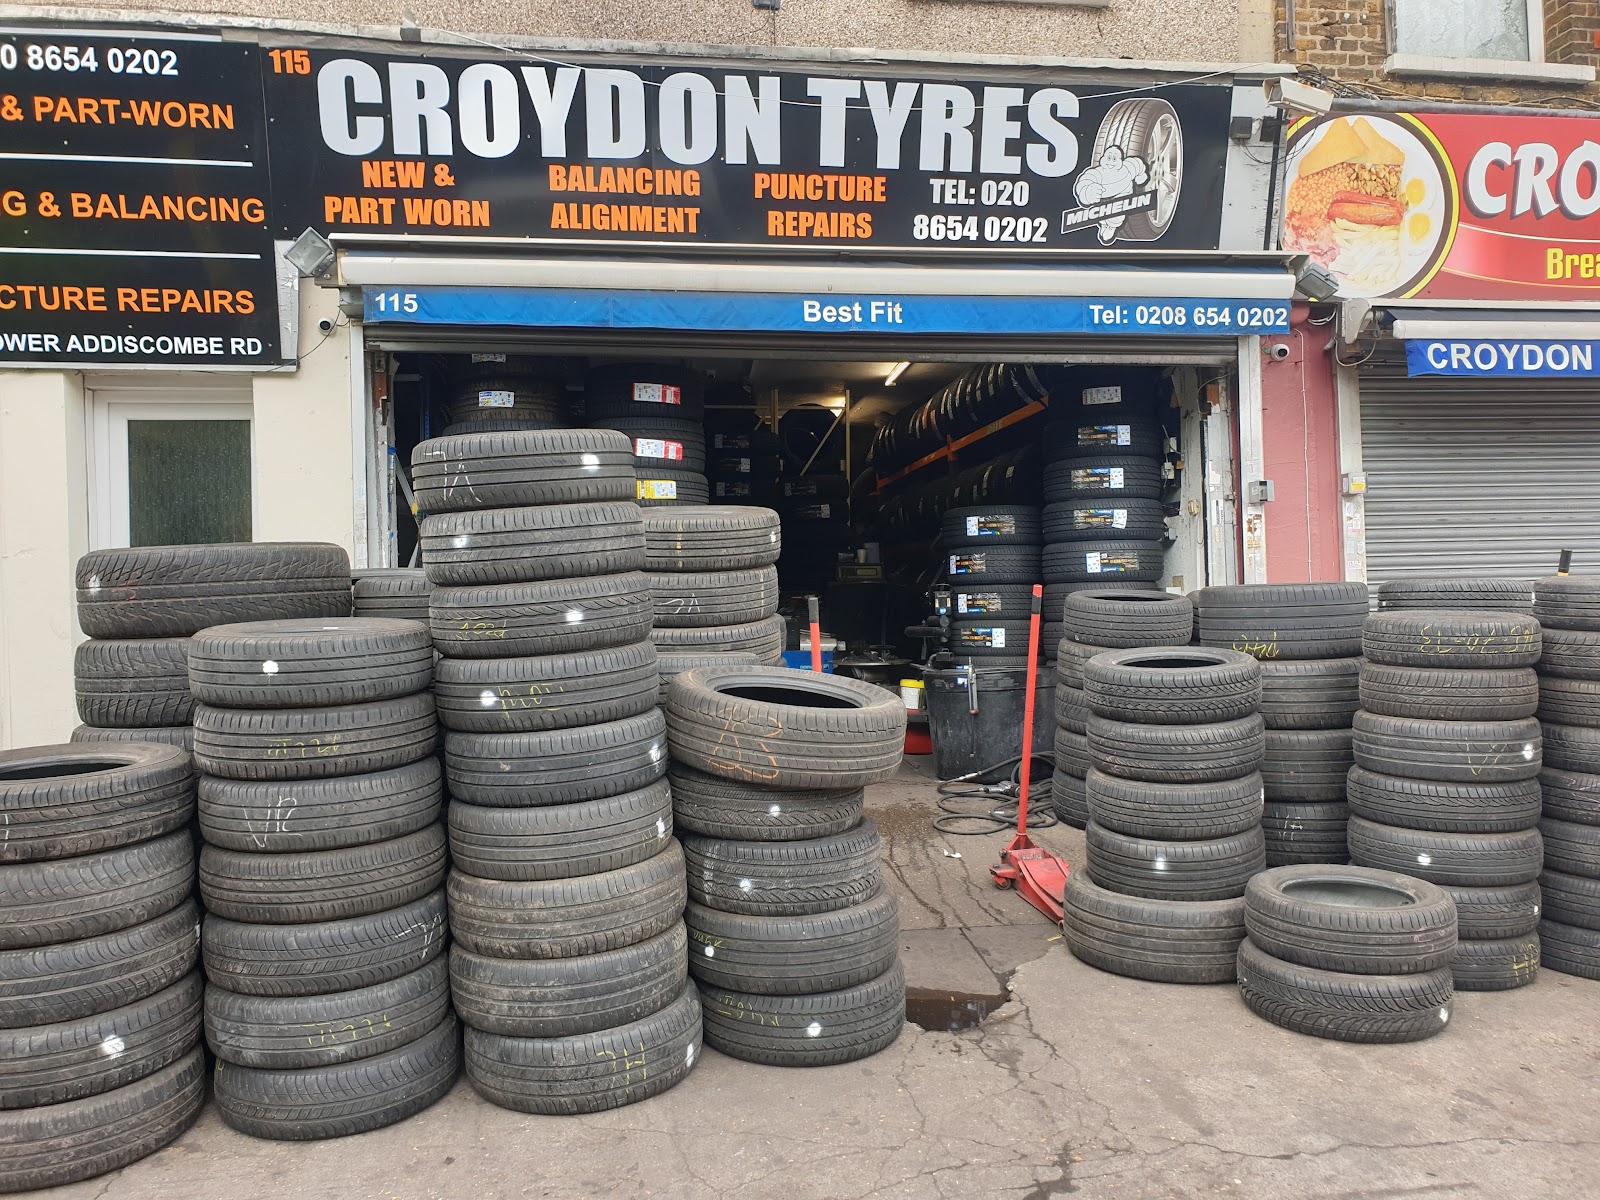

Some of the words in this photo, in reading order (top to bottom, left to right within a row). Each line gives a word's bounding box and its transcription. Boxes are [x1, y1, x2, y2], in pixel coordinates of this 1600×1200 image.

[27, 45, 98, 73] 8654
[107, 49, 179, 76] 0202
[1, 95, 24, 121] &
[34, 96, 234, 130] PART-WORN
[269, 49, 311, 75] 115
[316, 57, 781, 166] CROYDON
[806, 77, 1080, 178] TYRES
[362, 161, 425, 188] NEW
[433, 164, 456, 187] &
[549, 164, 701, 197] BALANCING
[754, 172, 887, 203] PUNCTURE
[1, 190, 27, 217] G
[37, 191, 62, 218] &
[71, 193, 266, 223] BALANCING
[929, 178, 976, 205] TEL:
[981, 179, 1030, 207] 020
[324, 196, 397, 225] PART
[402, 199, 491, 228] WORN
[550, 202, 700, 234] ALIGNMENT
[767, 210, 873, 239] REPAIRS
[1066, 193, 1152, 226] MICHELIN
[912, 214, 979, 241] 8654
[984, 216, 1049, 243] 0202
[116, 288, 256, 315] REPAIRS
[374, 293, 419, 314] 115
[802, 300, 863, 324] Best
[870, 302, 904, 325] Fit
[1089, 304, 1129, 325] Tel:
[1135, 305, 1187, 326] 0208
[1192, 307, 1232, 327] 654
[1236, 308, 1288, 328] 0202
[0, 333, 62, 353] WER
[65, 334, 224, 356] ADDISCOMBE
[229, 336, 263, 356] RD
[1426, 342, 1593, 372] CROYDON
